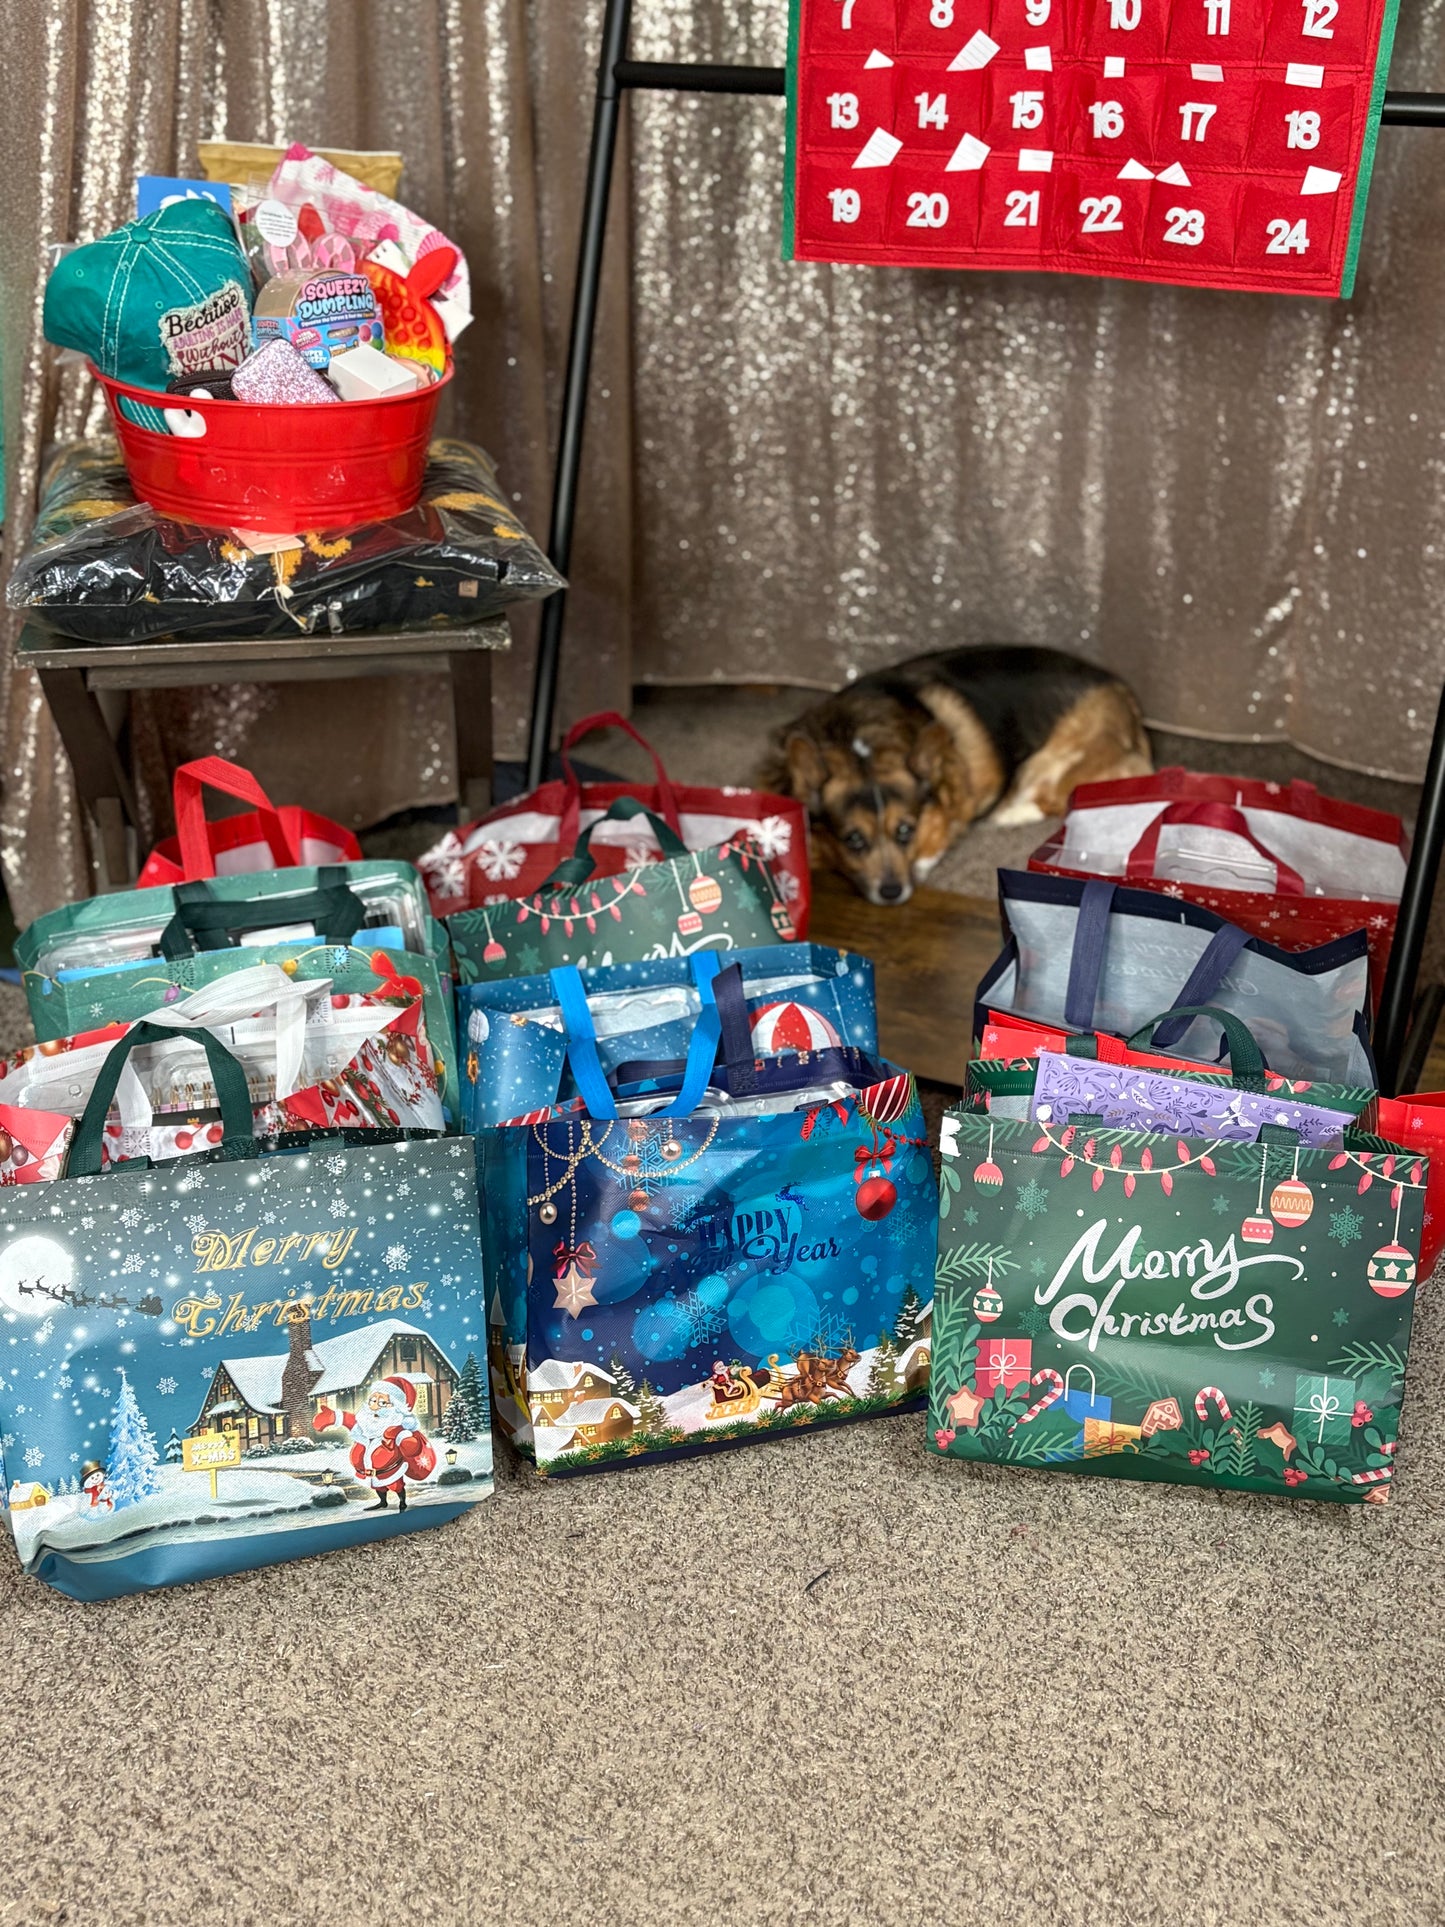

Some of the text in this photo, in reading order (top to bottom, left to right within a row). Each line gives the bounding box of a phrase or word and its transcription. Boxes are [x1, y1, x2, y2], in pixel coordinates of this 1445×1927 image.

[834, 0, 857, 30] 7
[929, 0, 955, 29] 8
[1025, 0, 1051, 27] 9
[1106, 0, 1142, 31] 10
[1203, 0, 1231, 36] 11
[1301, 0, 1339, 40] 12
[826, 92, 860, 130] 13
[914, 92, 949, 130] 14
[1009, 90, 1045, 129] 15
[1088, 100, 1125, 139] 16
[1178, 101, 1218, 142] 17
[1284, 110, 1321, 150] 18
[827, 188, 861, 224] 19
[906, 191, 950, 229] 20
[1003, 190, 1040, 227] 21
[1078, 194, 1124, 233] 22
[1162, 206, 1206, 246] 23
[1265, 218, 1310, 255] 24
[300, 293, 374, 319] DUMPLING
[305, 278, 368, 301] SQUEEZY
[165, 287, 240, 338] Because
[173, 326, 216, 350] ADULTING
[215, 319, 227, 334] IS
[185, 329, 243, 363] Without
[699, 1206, 792, 1252] HAPPY
[191, 1226, 359, 1273] Merry
[739, 1231, 842, 1276] Year
[1034, 1218, 1305, 1305] Merry
[172, 1280, 429, 1337] Christmas
[1049, 1278, 1275, 1352] Christmas
[191, 1448, 236, 1465] X-MAS
